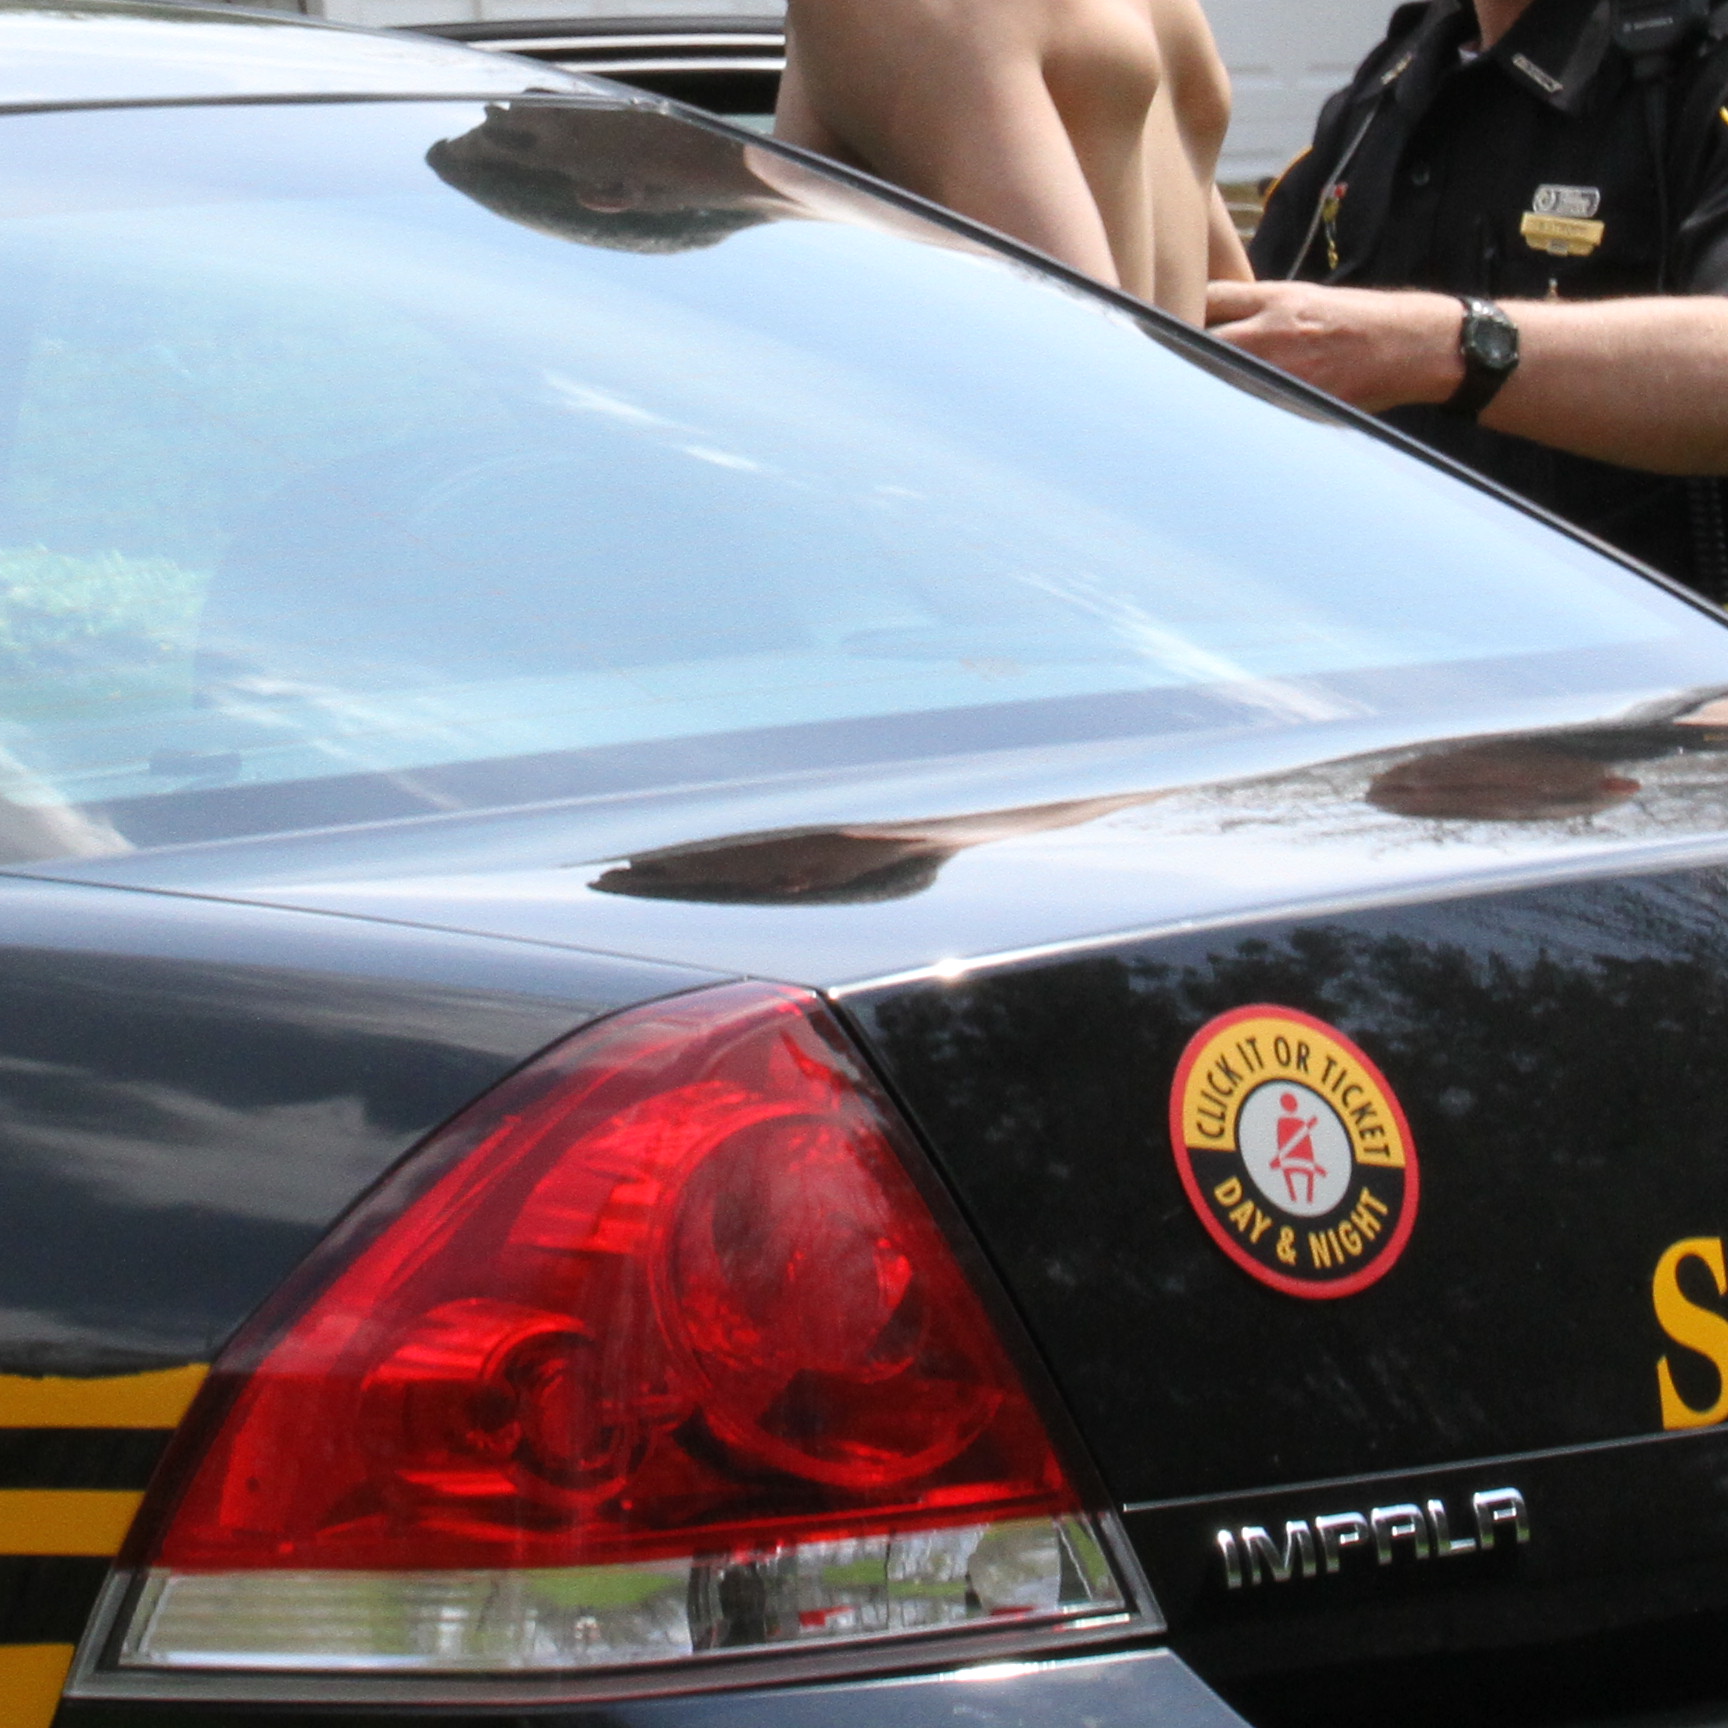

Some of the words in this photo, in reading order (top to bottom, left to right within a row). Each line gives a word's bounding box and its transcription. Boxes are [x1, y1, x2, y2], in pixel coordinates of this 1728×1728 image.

[1196, 1053, 1244, 1140] CLICK
[1236, 1037, 1265, 1072] IT
[1273, 1036, 1311, 1073] OR
[1320, 1056, 1391, 1158] TICKET
[1214, 1176, 1272, 1244] DAY
[1276, 1225, 1297, 1266] &
[1308, 1187, 1389, 1269] NIGHT
[1217, 1487, 1530, 1589] IMPALA
